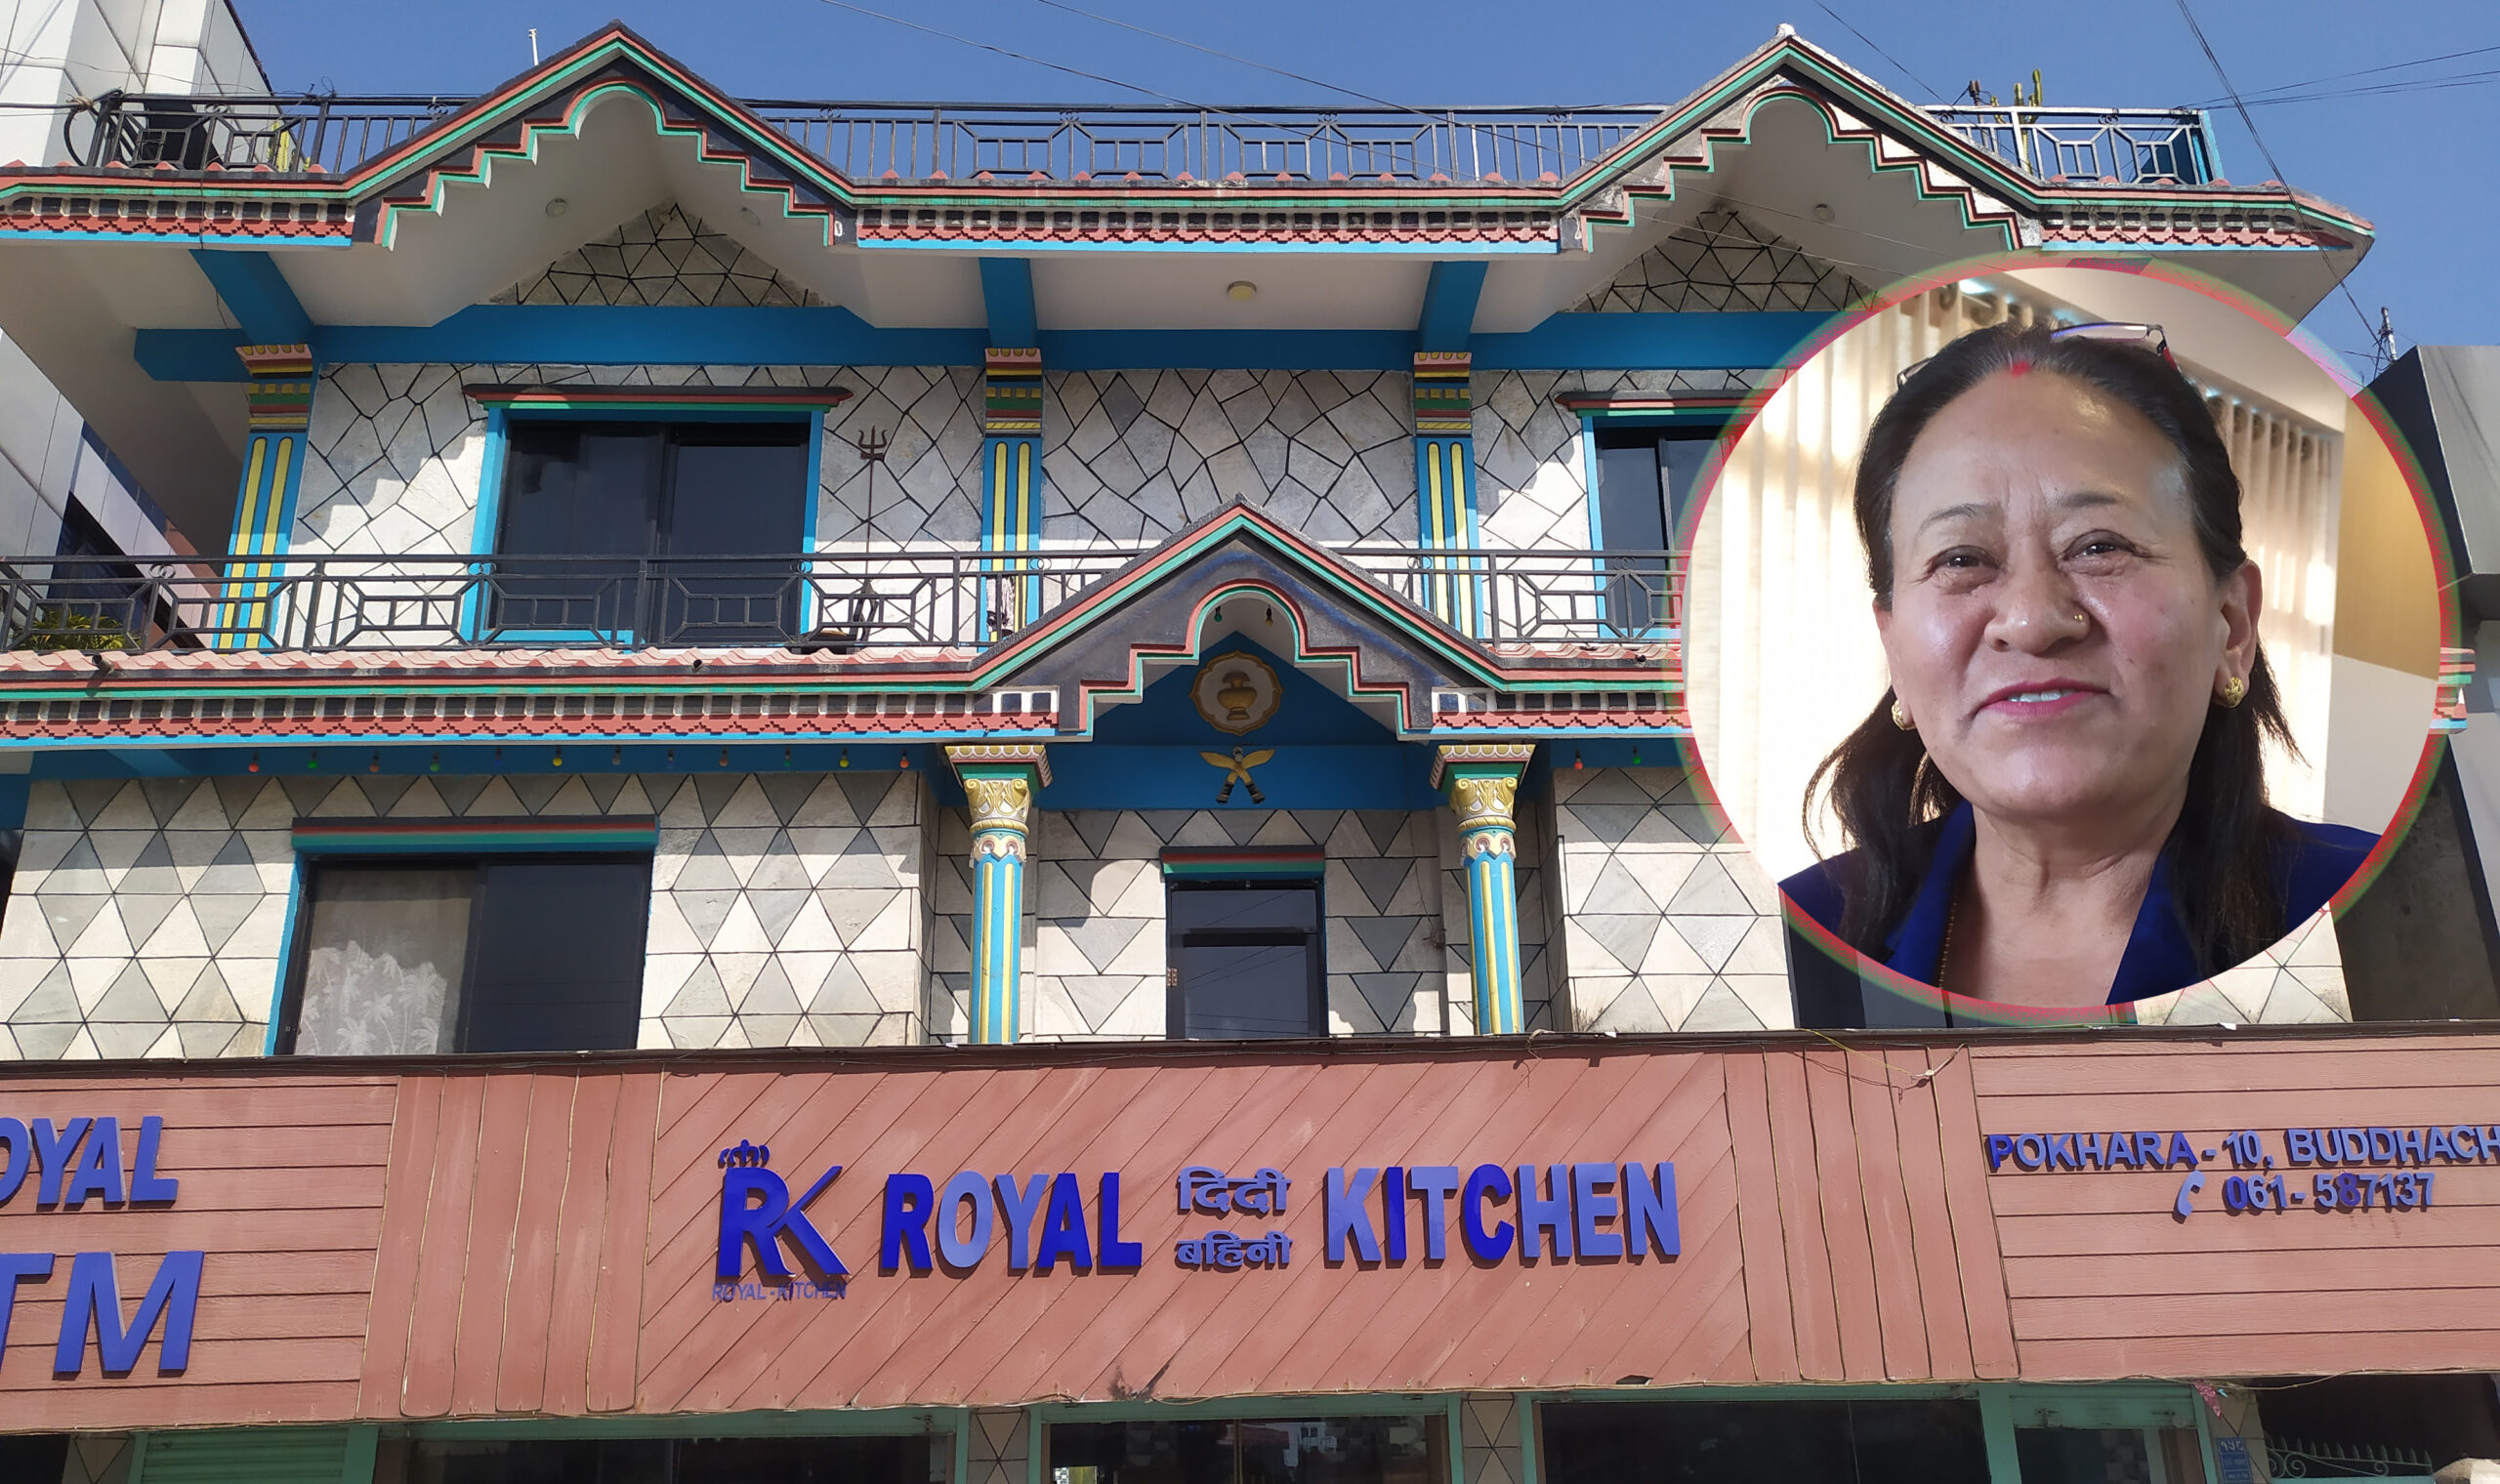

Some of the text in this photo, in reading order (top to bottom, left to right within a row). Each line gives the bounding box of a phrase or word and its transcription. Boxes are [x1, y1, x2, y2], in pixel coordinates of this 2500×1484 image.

[717, 1166, 851, 1276] RK
[882, 1162, 1681, 1269] ROYAL KITCHEN
[1177, 1166, 1293, 1213] दिदी
[1177, 1230, 1293, 1267] बहिनी
